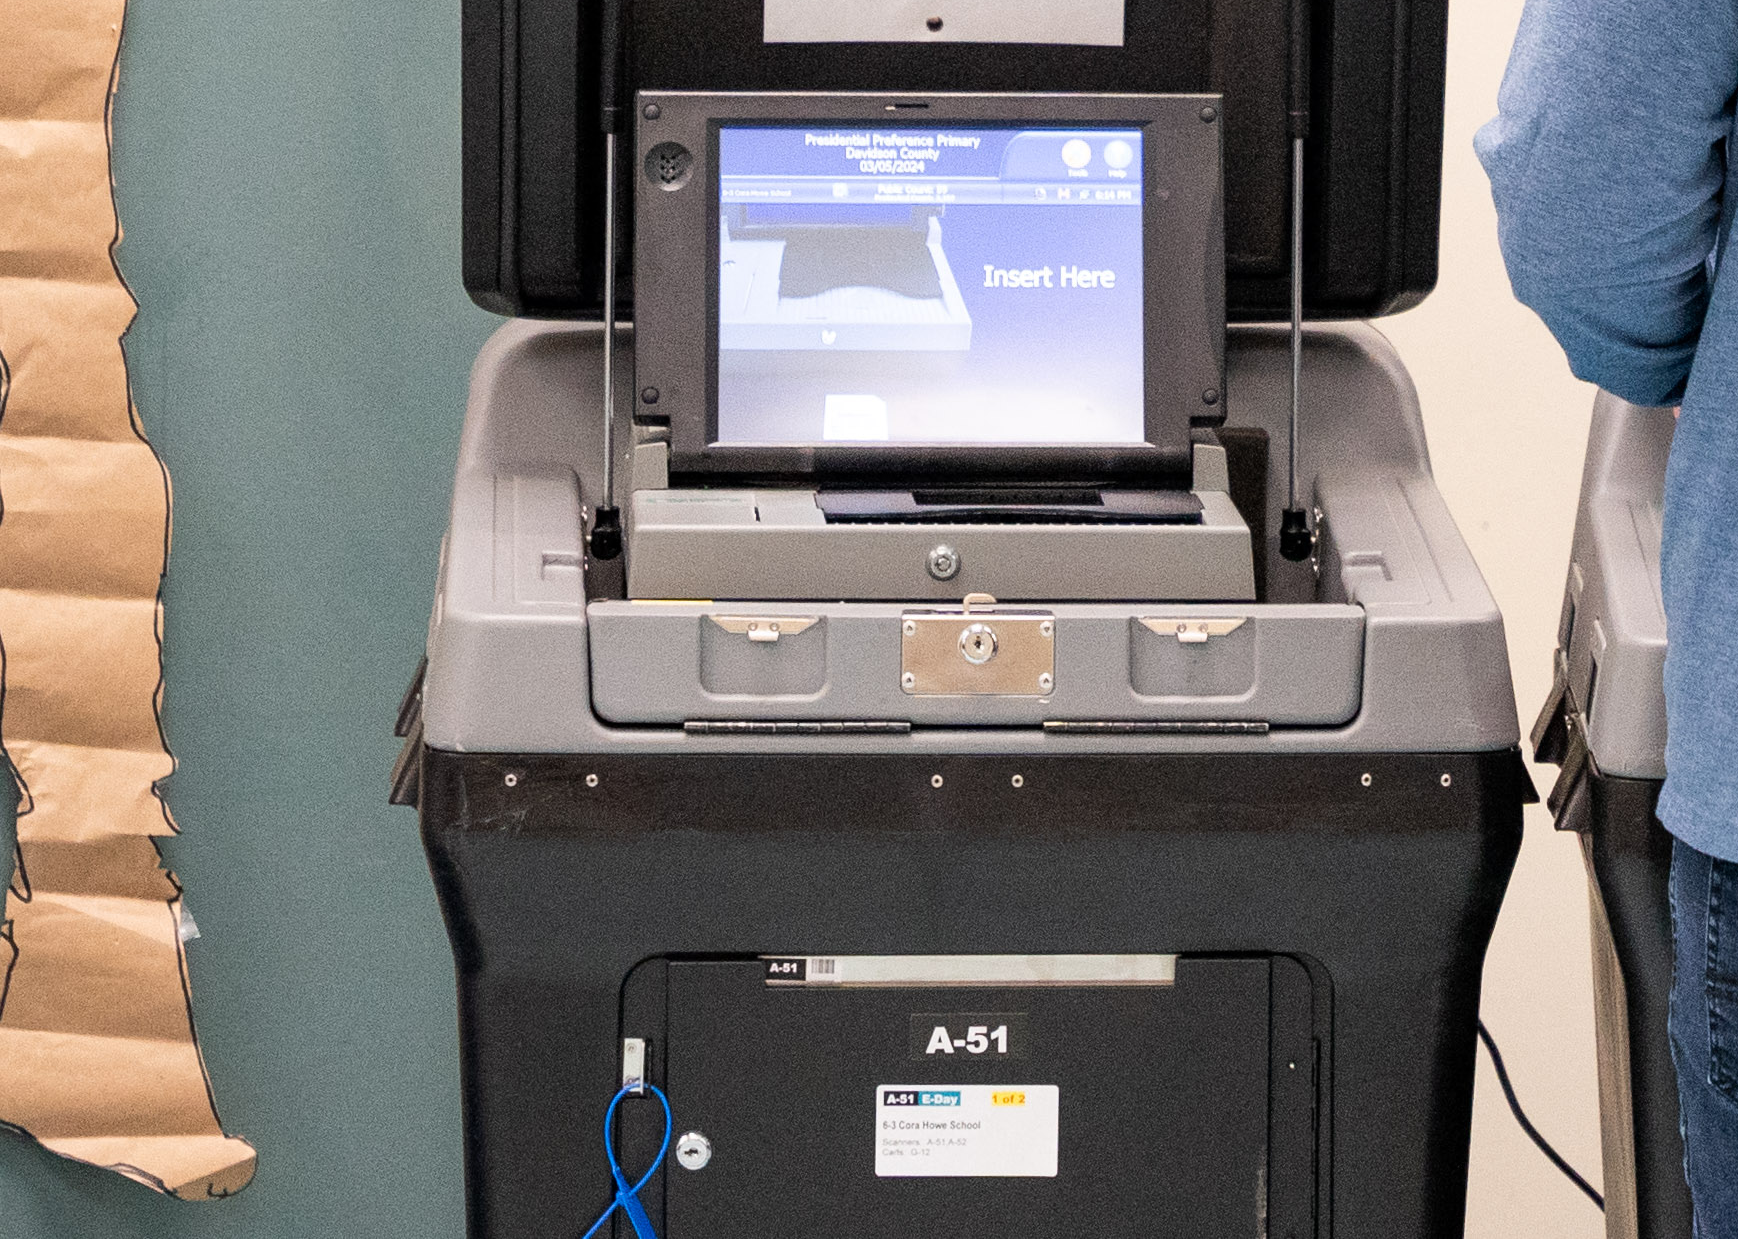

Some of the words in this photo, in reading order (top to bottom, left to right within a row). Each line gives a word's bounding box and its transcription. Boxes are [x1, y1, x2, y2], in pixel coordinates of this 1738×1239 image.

[804, 133, 870, 147] Presidential
[872, 134, 934, 147] Preference
[936, 134, 981, 150] Primary
[845, 147, 897, 160] Davidson
[899, 147, 940, 162] County
[859, 160, 925, 174] 03/05/2024
[983, 264, 1053, 288] Insert
[1060, 265, 1116, 289] Here
[768, 962, 799, 974] A-51
[925, 1025, 1009, 1054] A-51
[886, 1093, 915, 1105] A-51
[921, 1093, 959, 1106] E-Day
[1002, 1094, 1014, 1104] of
[898, 1120, 920, 1130] Cora
[922, 1120, 947, 1130] Howe
[949, 1120, 981, 1130] School
